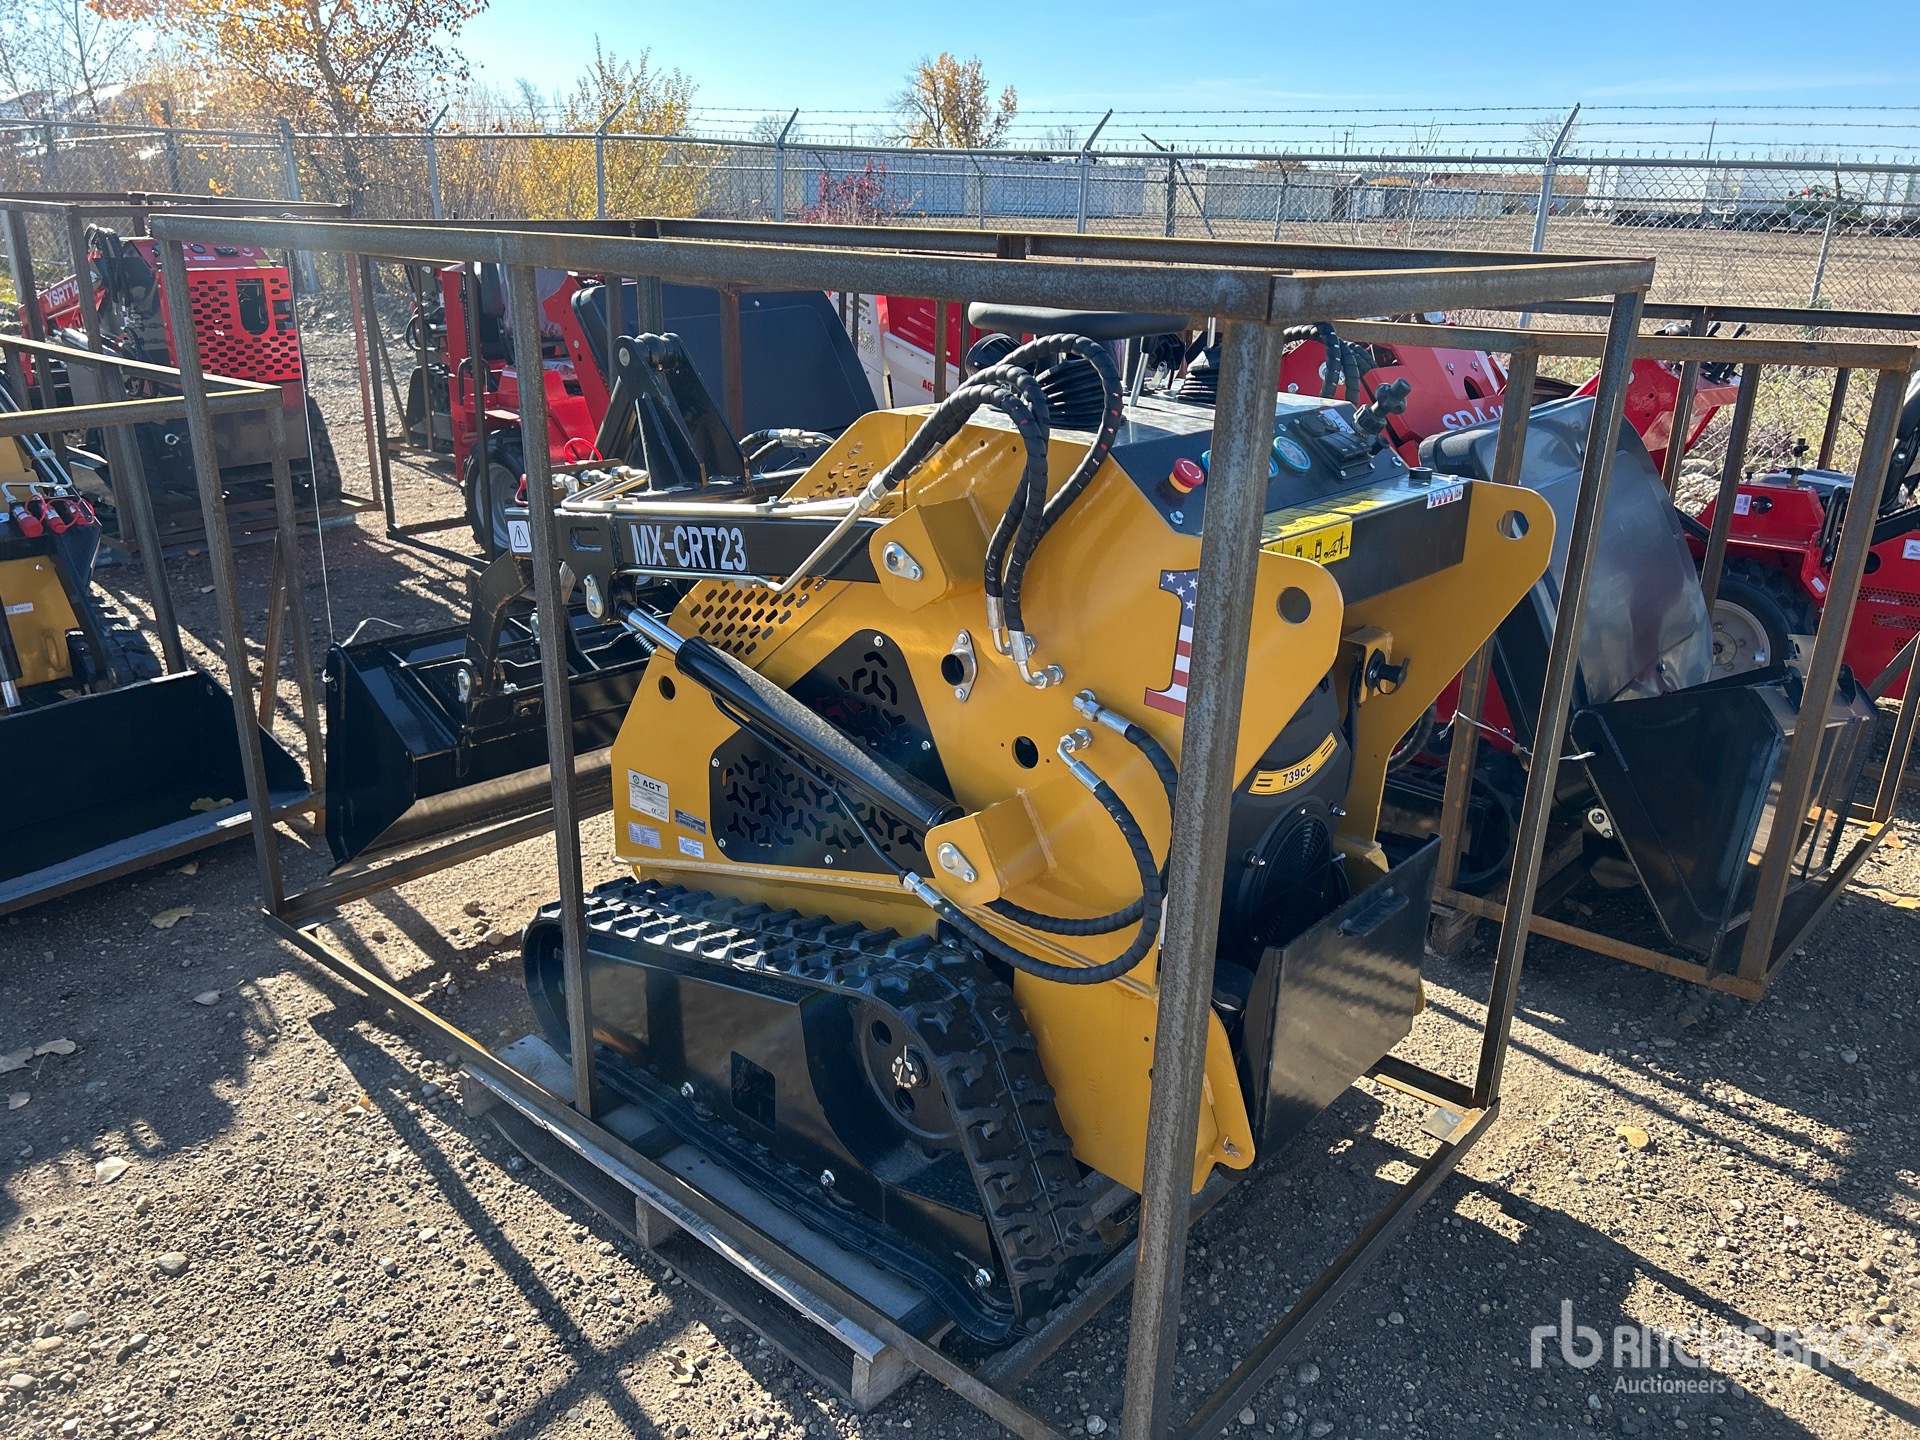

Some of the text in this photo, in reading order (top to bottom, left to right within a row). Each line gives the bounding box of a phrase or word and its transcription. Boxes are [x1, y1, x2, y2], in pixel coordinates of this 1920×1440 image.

[630, 524, 747, 572] MX-CRT23
[642, 779, 661, 792] AGT
[1282, 763, 1312, 787] 739cc
